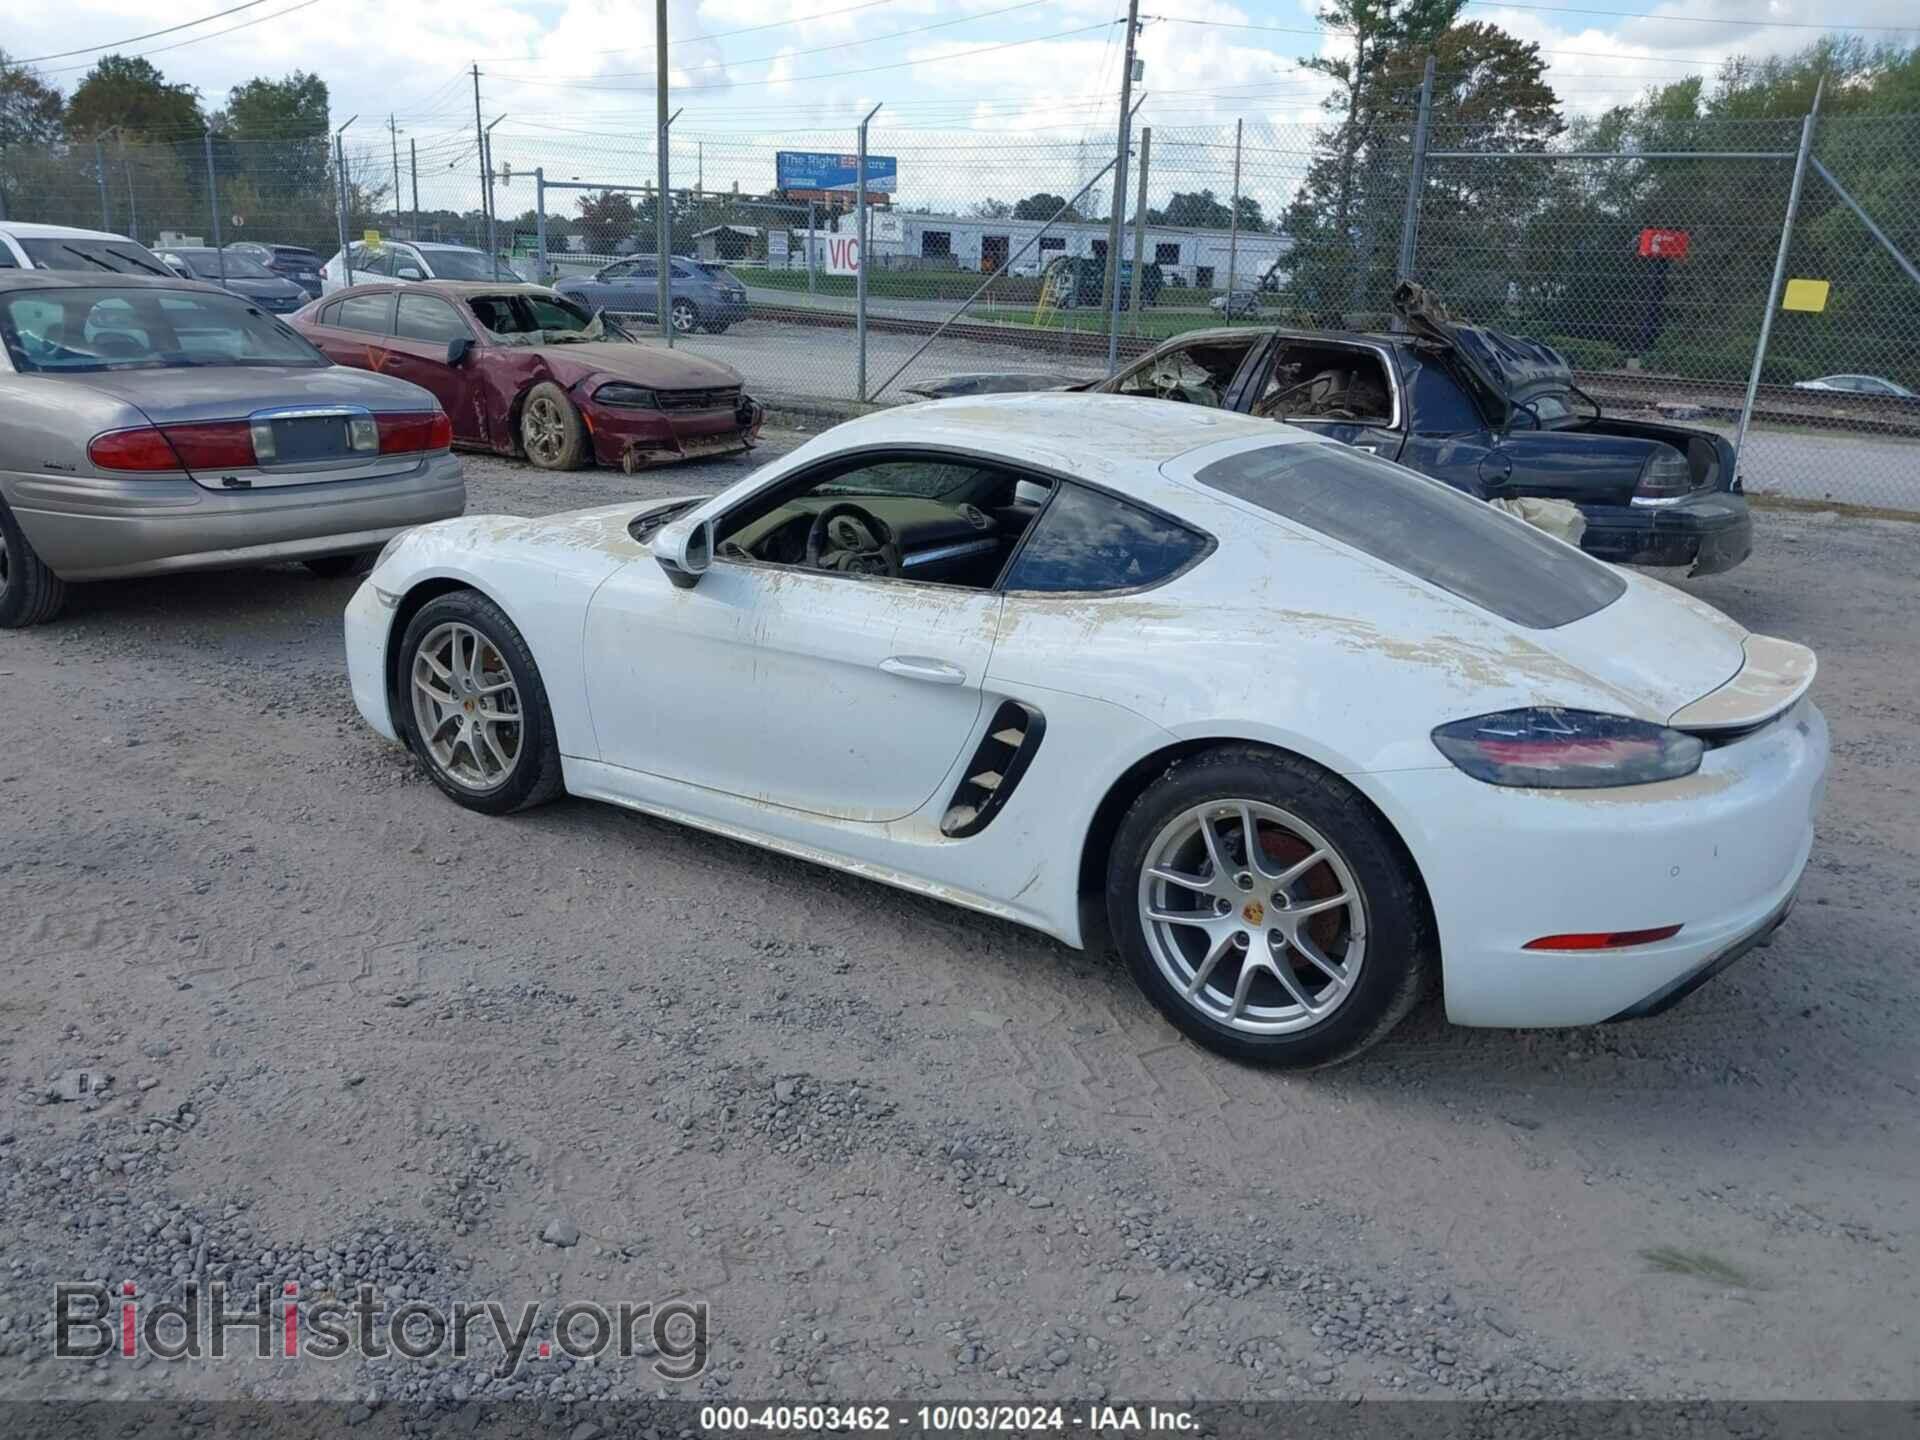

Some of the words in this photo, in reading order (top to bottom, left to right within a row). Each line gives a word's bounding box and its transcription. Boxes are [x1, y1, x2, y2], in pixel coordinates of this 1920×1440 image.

[784, 154, 803, 165] The
[807, 155, 837, 169] Right
[829, 238, 859, 270] VIC
